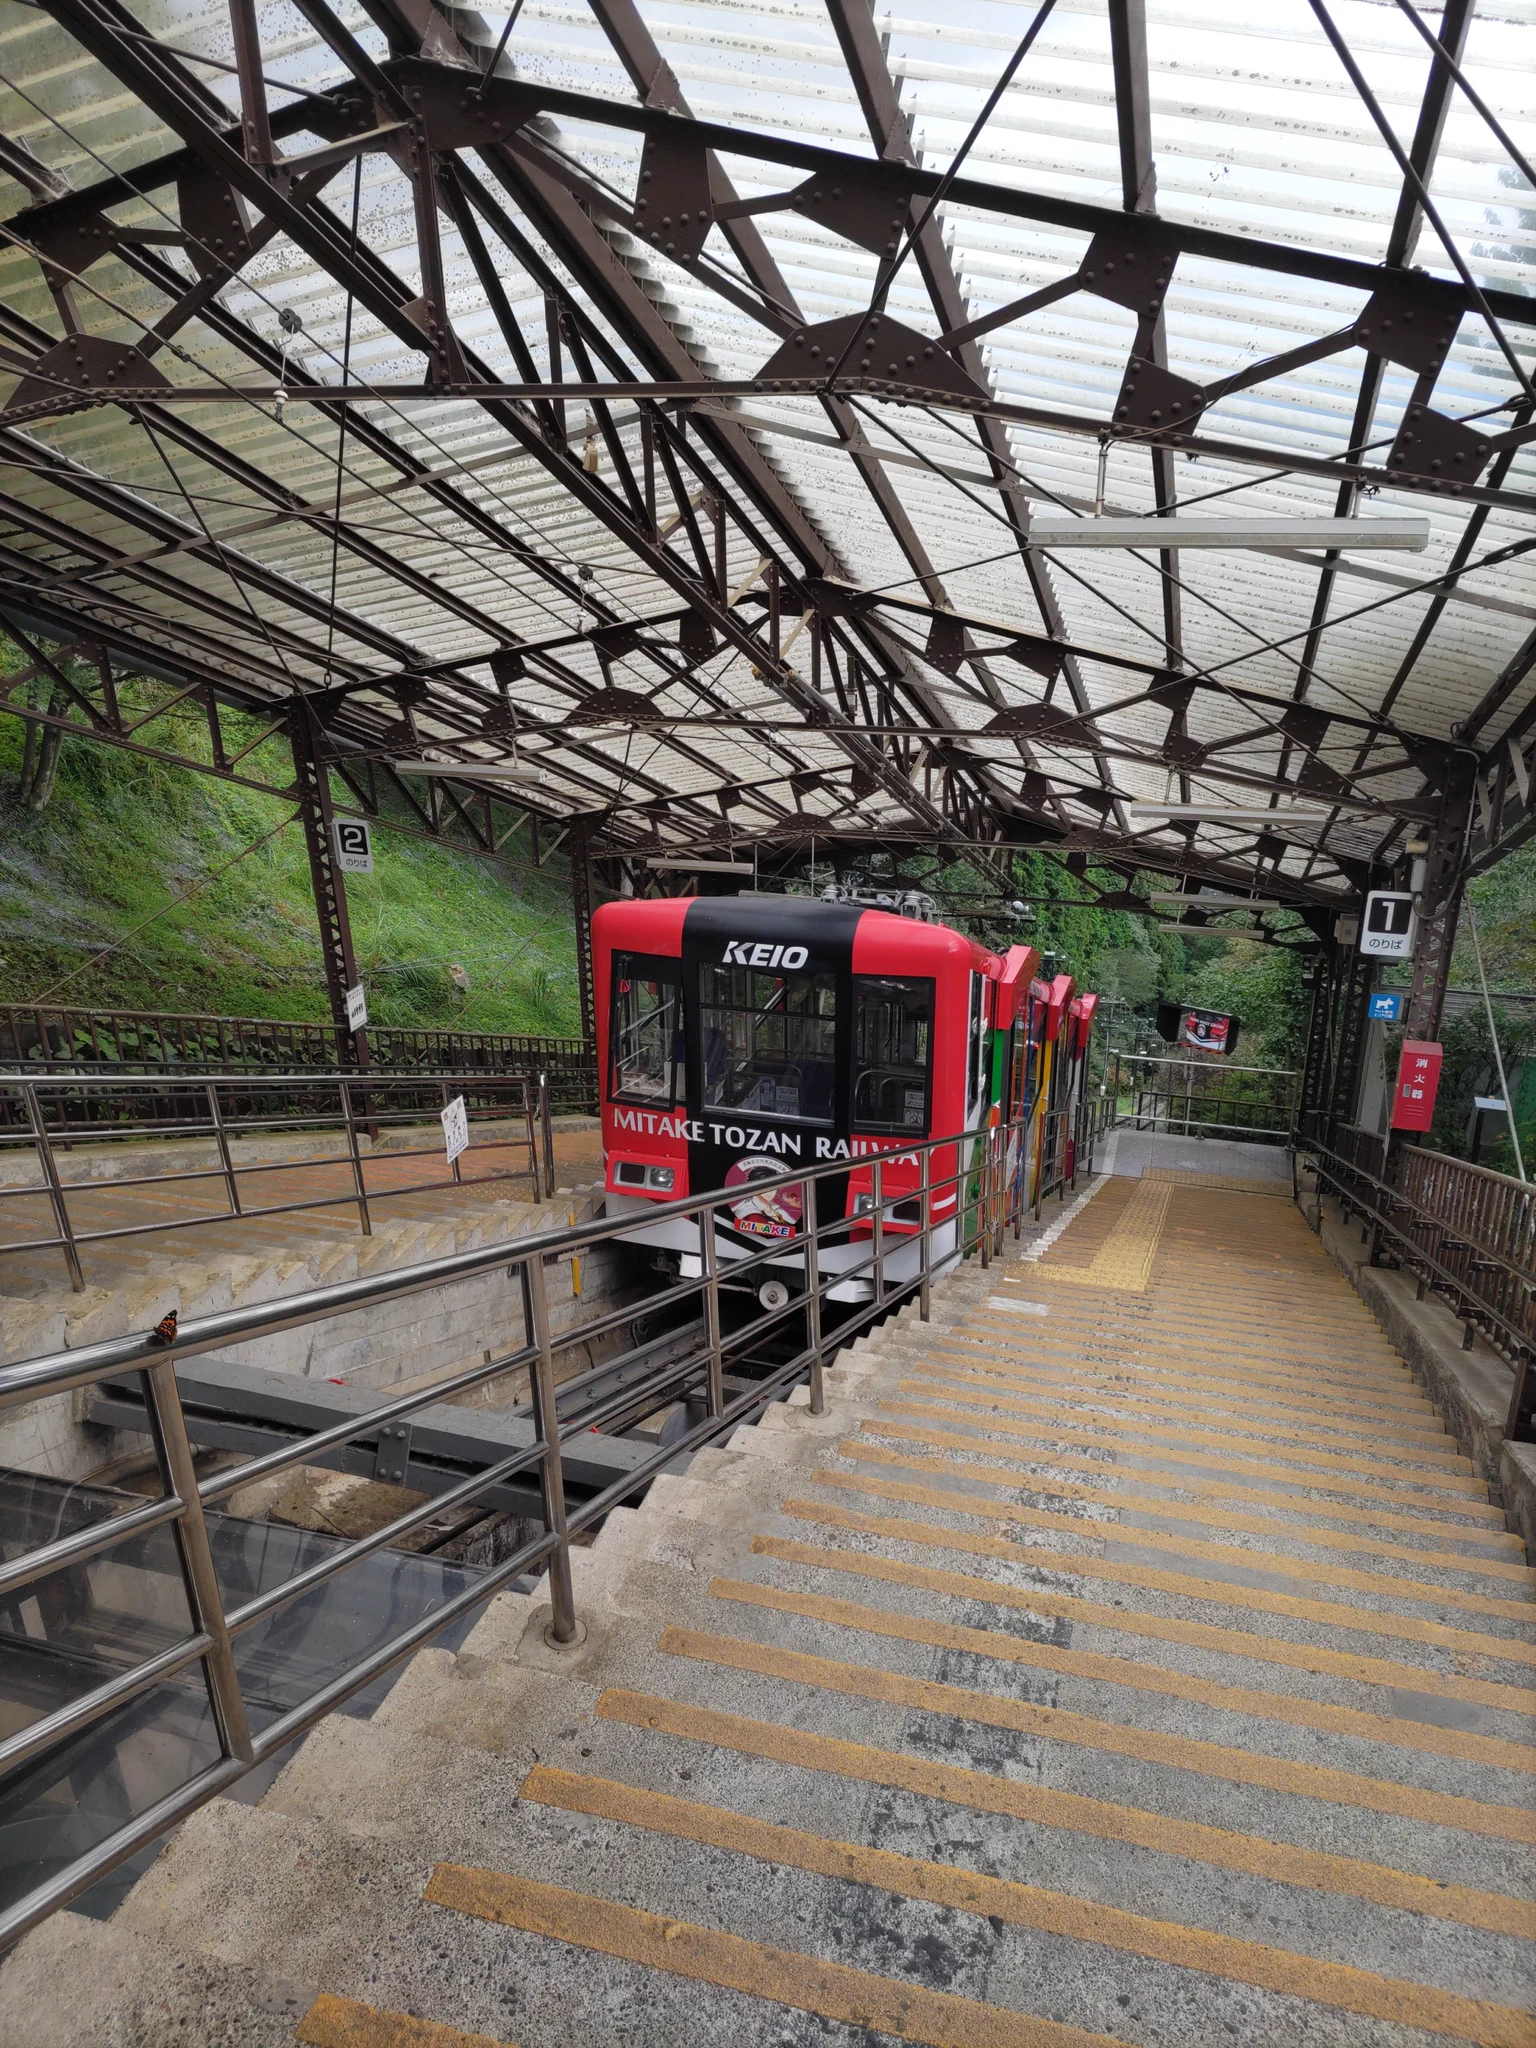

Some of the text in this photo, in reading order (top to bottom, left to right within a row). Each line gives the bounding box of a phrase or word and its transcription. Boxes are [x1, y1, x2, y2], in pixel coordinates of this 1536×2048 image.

[344, 827, 362, 852] 2
[346, 858, 368, 868] のりば
[1382, 901, 1395, 931] 1
[722, 941, 809, 969] KEIO
[1369, 939, 1403, 949] のりば
[1411, 1058, 1428, 1099] 消火器
[614, 1108, 705, 1142] MITAKE
[709, 1123, 801, 1155] TOZAN
[740, 1221, 790, 1236] MITAKE
